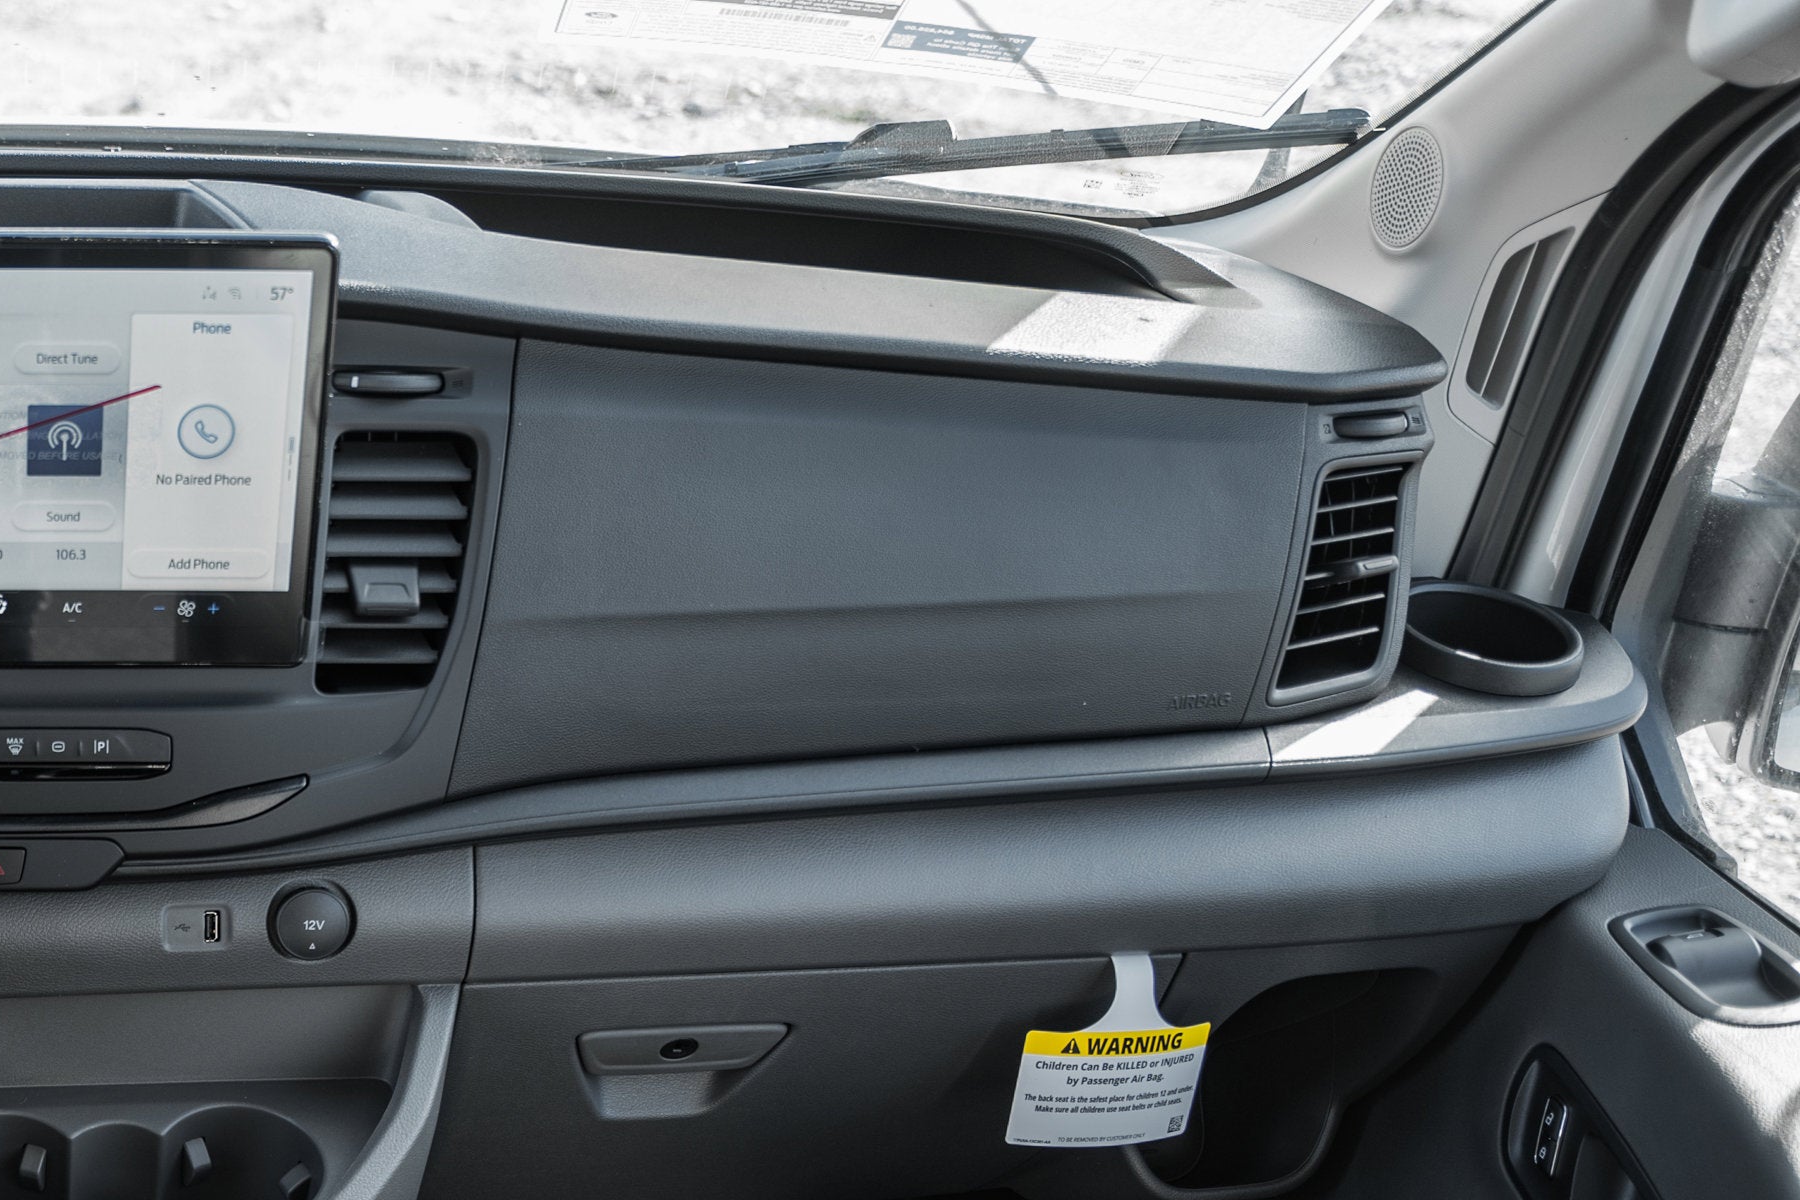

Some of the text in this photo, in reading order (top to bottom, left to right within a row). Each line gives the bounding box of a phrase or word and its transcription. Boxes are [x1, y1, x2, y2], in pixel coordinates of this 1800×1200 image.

[192, 321, 232, 335] Phone
[36, 353, 99, 365] Direct Tune
[155, 474, 252, 487] No Paired Phone
[45, 511, 81, 523] Sound
[55, 549, 87, 561] 106.3
[168, 558, 230, 571] Add Phone
[62, 602, 83, 615] A/C
[1167, 692, 1232, 712] AIRBAG
[6, 737, 25, 745] MAX
[303, 919, 326, 931] 12V
[1087, 1032, 1184, 1056] WARNING
[1035, 1053, 1195, 1071] Children Can Be KILLED or INJURED
[1066, 1073, 1165, 1087] by Passenger Air Bag.
[1024, 1093, 1037, 1101] The
[1037, 1094, 1054, 1102] back
[1108, 1094, 1125, 1104] place
[1125, 1093, 1136, 1101] for
[1135, 1091, 1159, 1100] children
[1160, 1089, 1167, 1097] 12
[1166, 1088, 1178, 1096] and
[1034, 1105, 1054, 1113] Make
[1071, 1105, 1080, 1113] all
[1080, 1105, 1105, 1114] children
[1117, 1104, 1131, 1112] seat
[1131, 1102, 1146, 1110] belts
[1153, 1099, 1167, 1108] child
